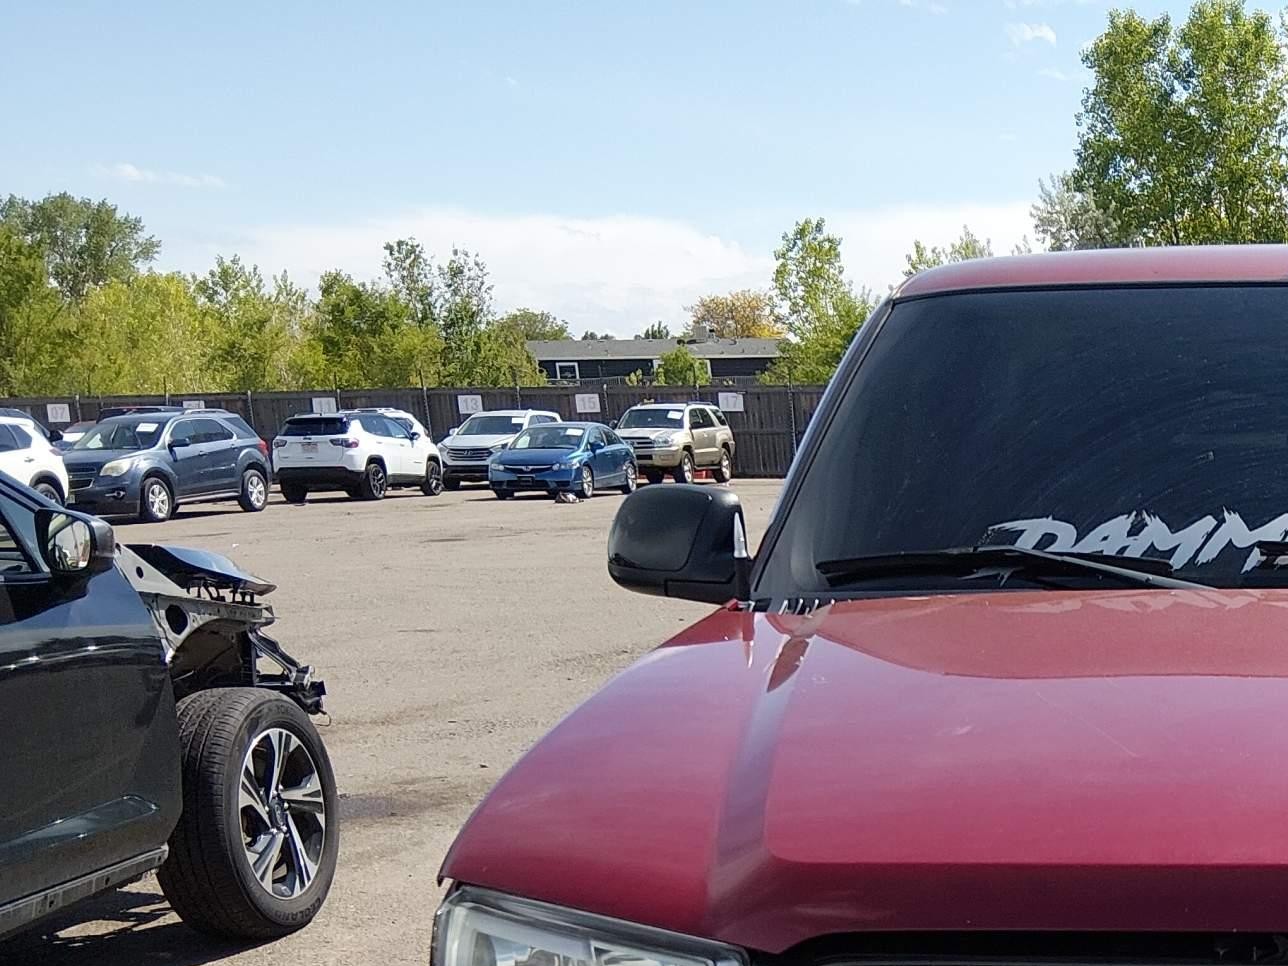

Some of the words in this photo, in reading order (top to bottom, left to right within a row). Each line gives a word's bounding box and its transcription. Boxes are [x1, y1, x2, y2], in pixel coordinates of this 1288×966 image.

[463, 397, 479, 411] 13
[581, 396, 596, 410] 15
[51, 406, 66, 420] 07
